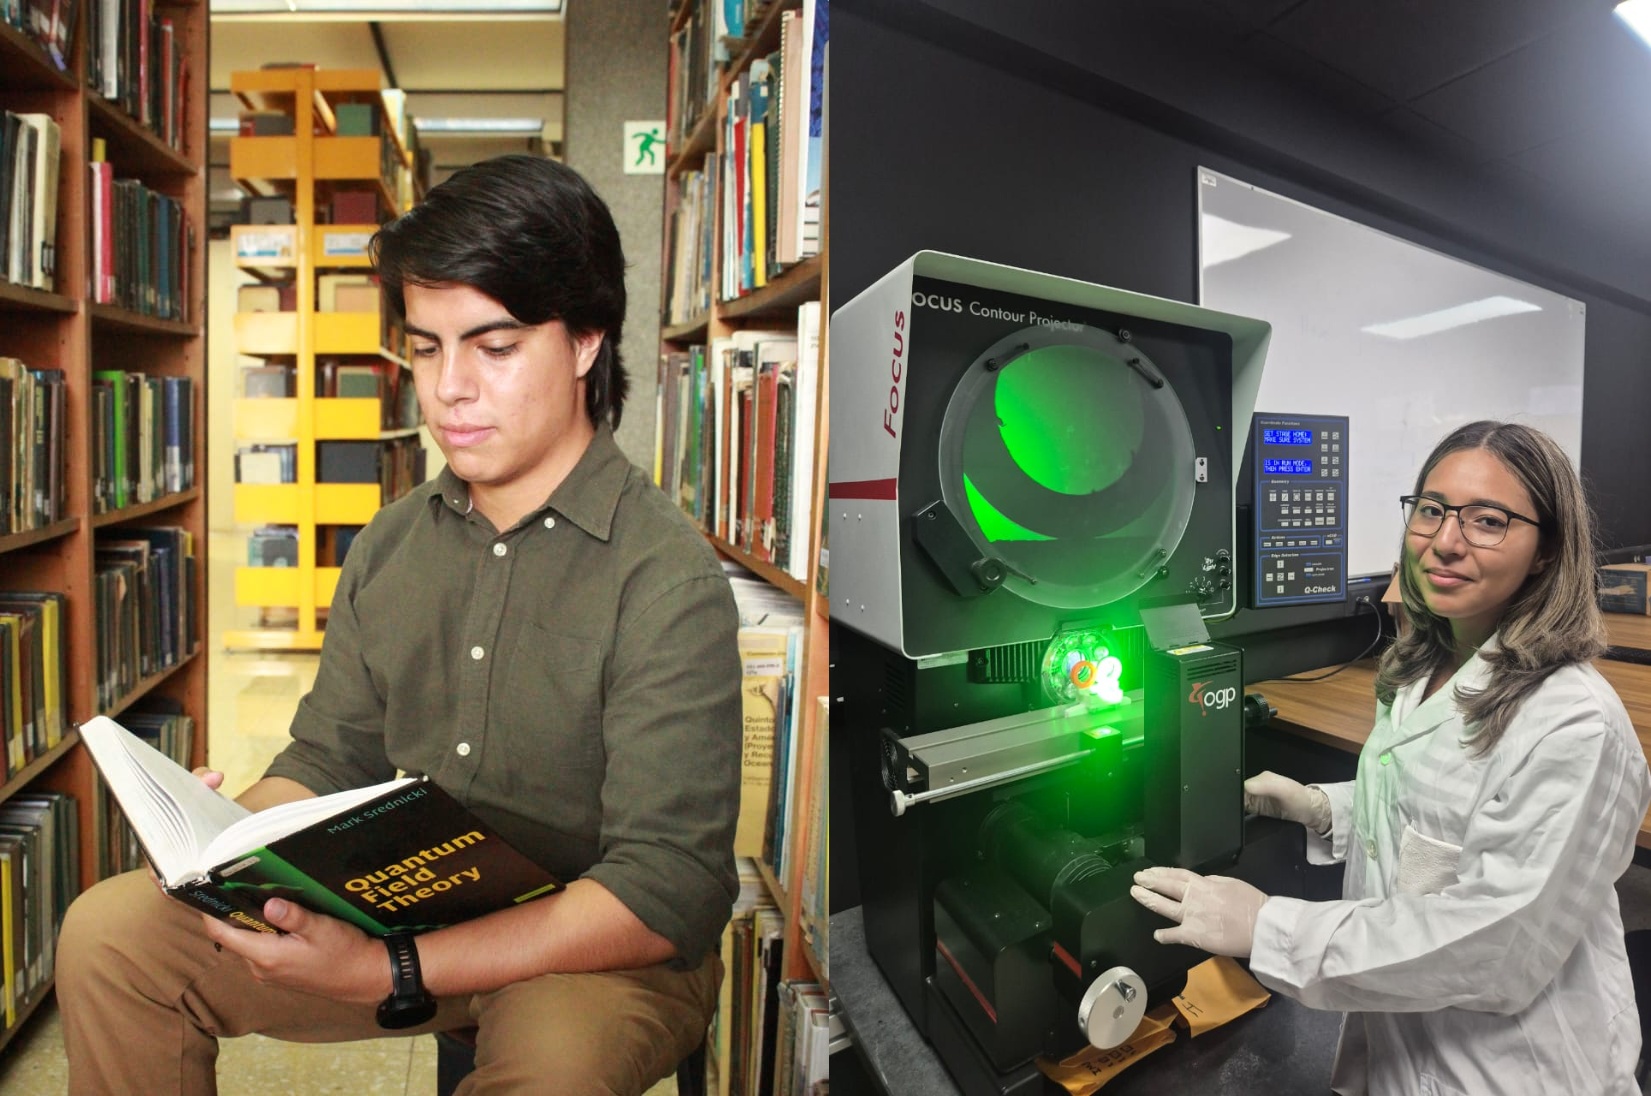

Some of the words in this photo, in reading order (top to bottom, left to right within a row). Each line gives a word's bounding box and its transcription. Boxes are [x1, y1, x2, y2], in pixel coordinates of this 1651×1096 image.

[912, 291, 963, 313] OCUS
[969, 301, 1026, 323] Contour
[1029, 311, 1085, 333] Projector
[1304, 585, 1336, 594] Q-Check
[1203, 686, 1236, 710] ogp
[326, 816, 365, 835] Mark
[363, 787, 428, 819] Srednicki
[344, 829, 487, 892] Quantum
[360, 866, 437, 904] Field
[375, 865, 481, 913] Theory
